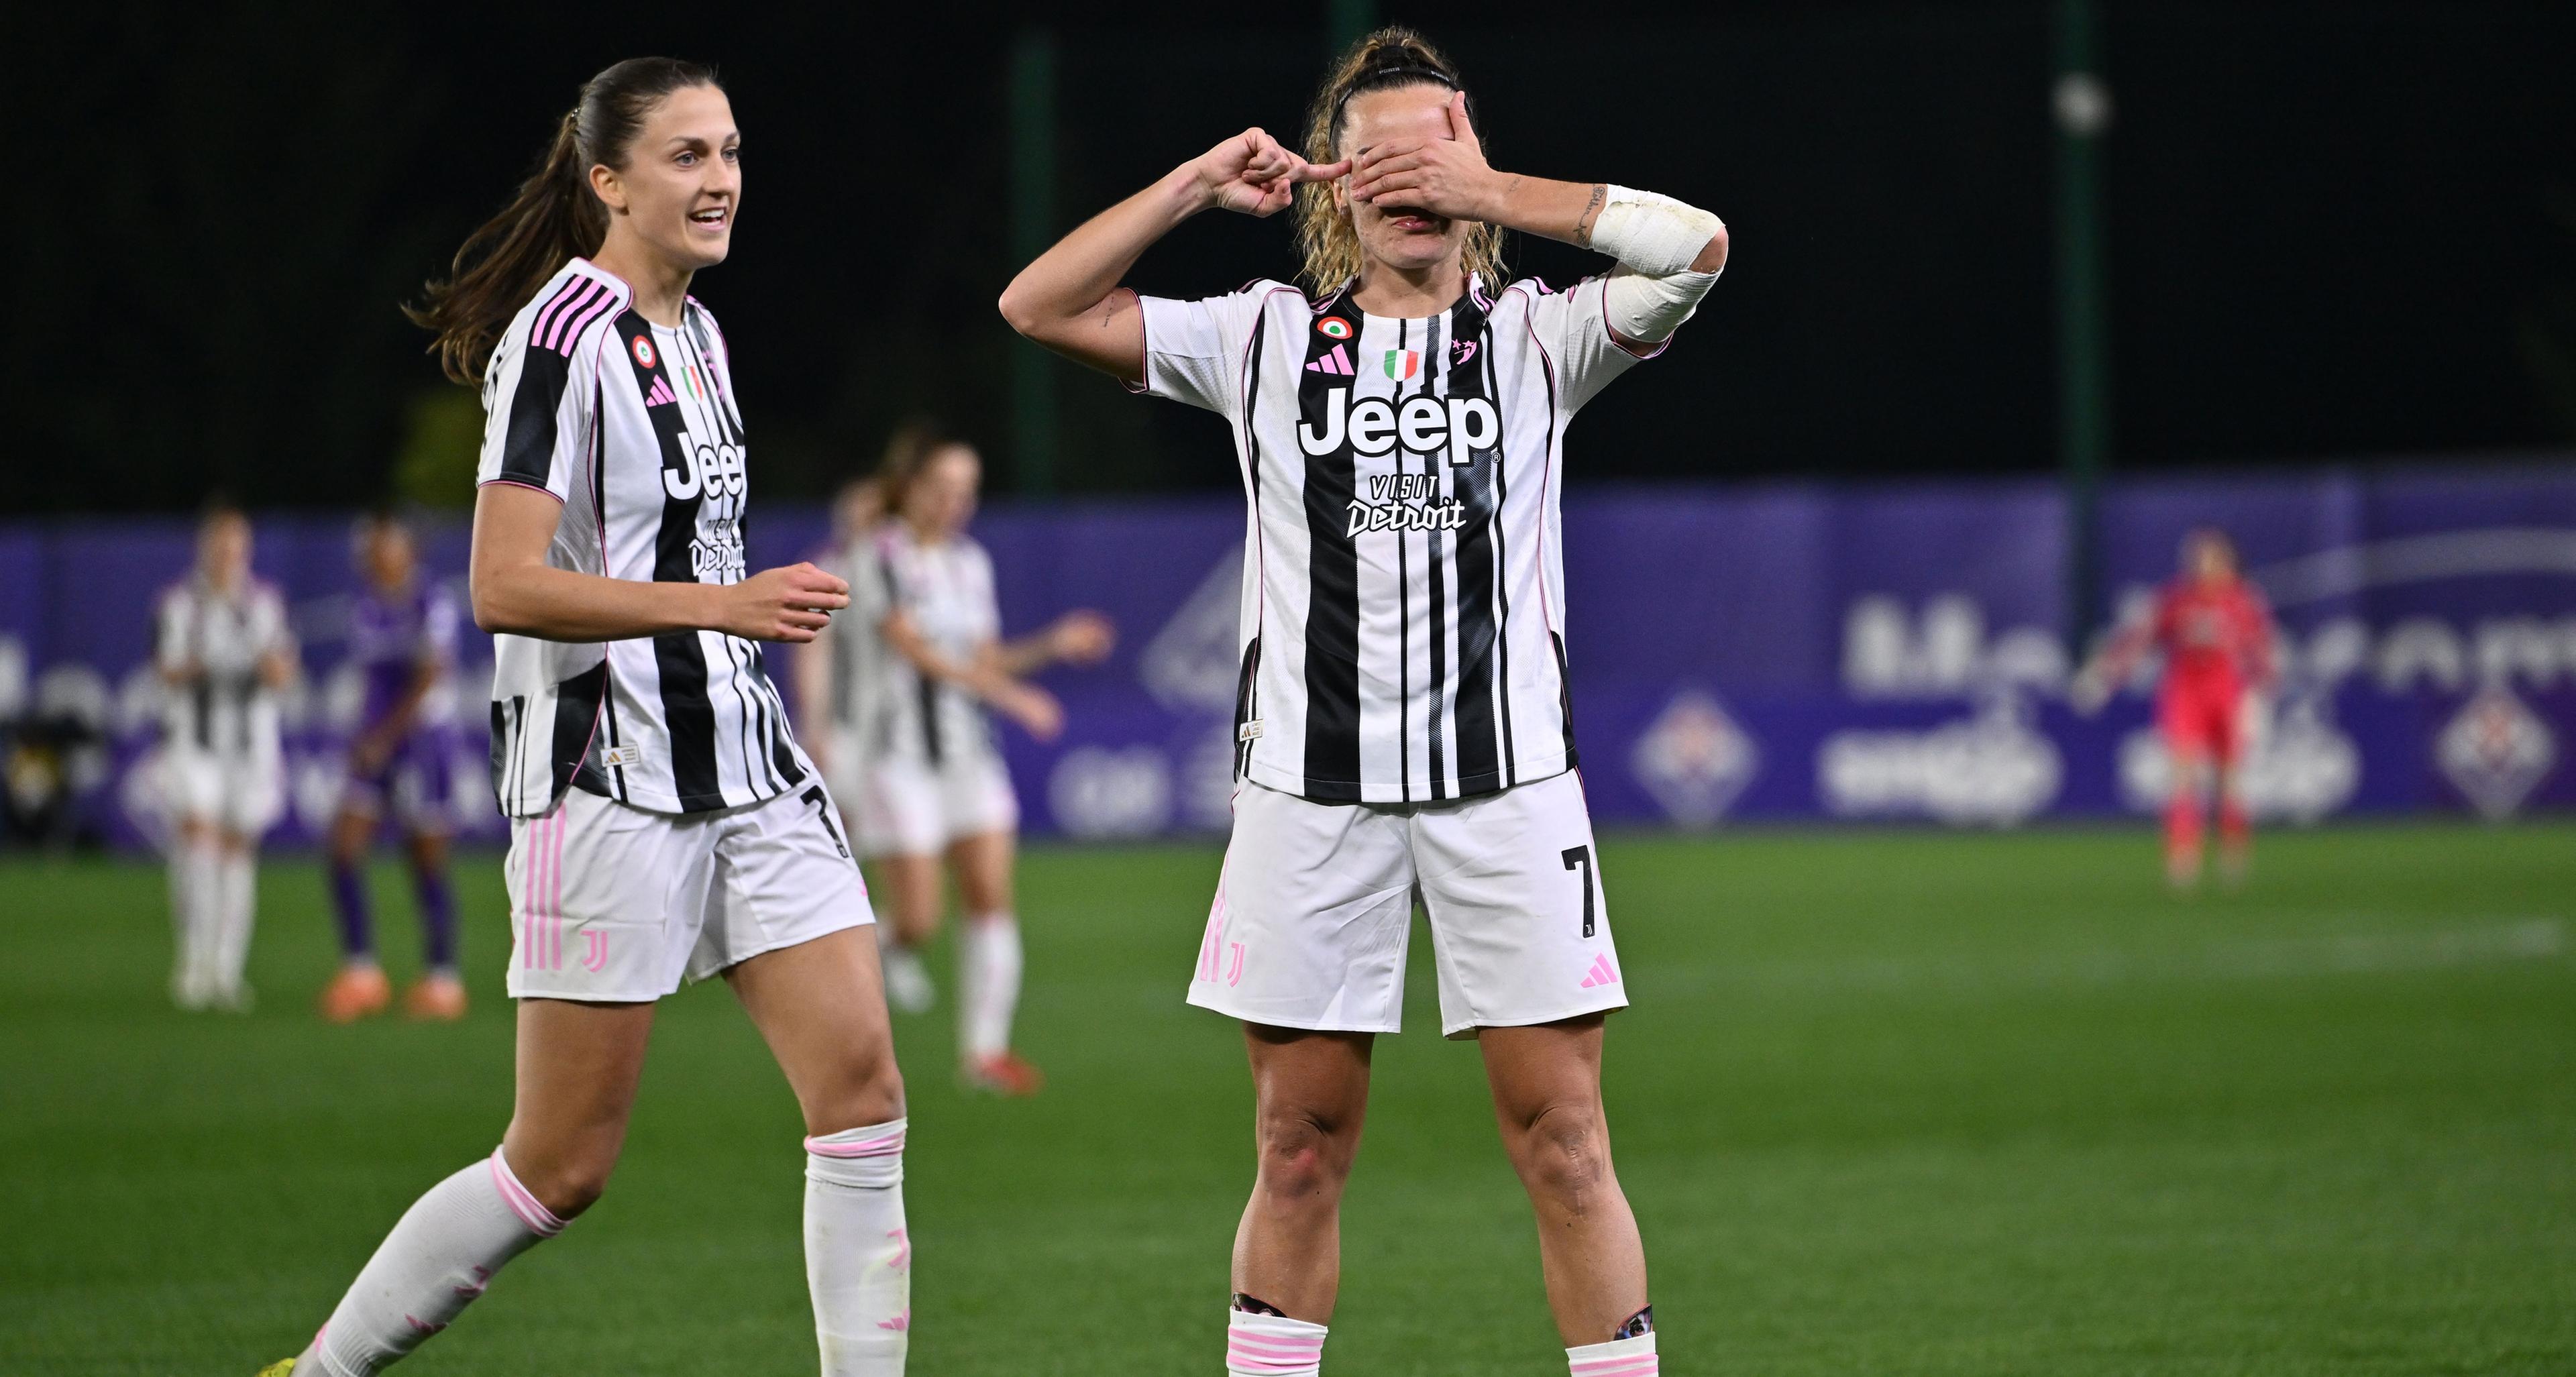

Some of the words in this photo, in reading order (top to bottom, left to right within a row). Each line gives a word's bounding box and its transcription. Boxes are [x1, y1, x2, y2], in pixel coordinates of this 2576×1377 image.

[1299, 387, 1499, 463] Jeep
[1370, 475, 1438, 499] VISIT
[1346, 499, 1467, 538] Detroit
[1561, 844, 1595, 938] 7
